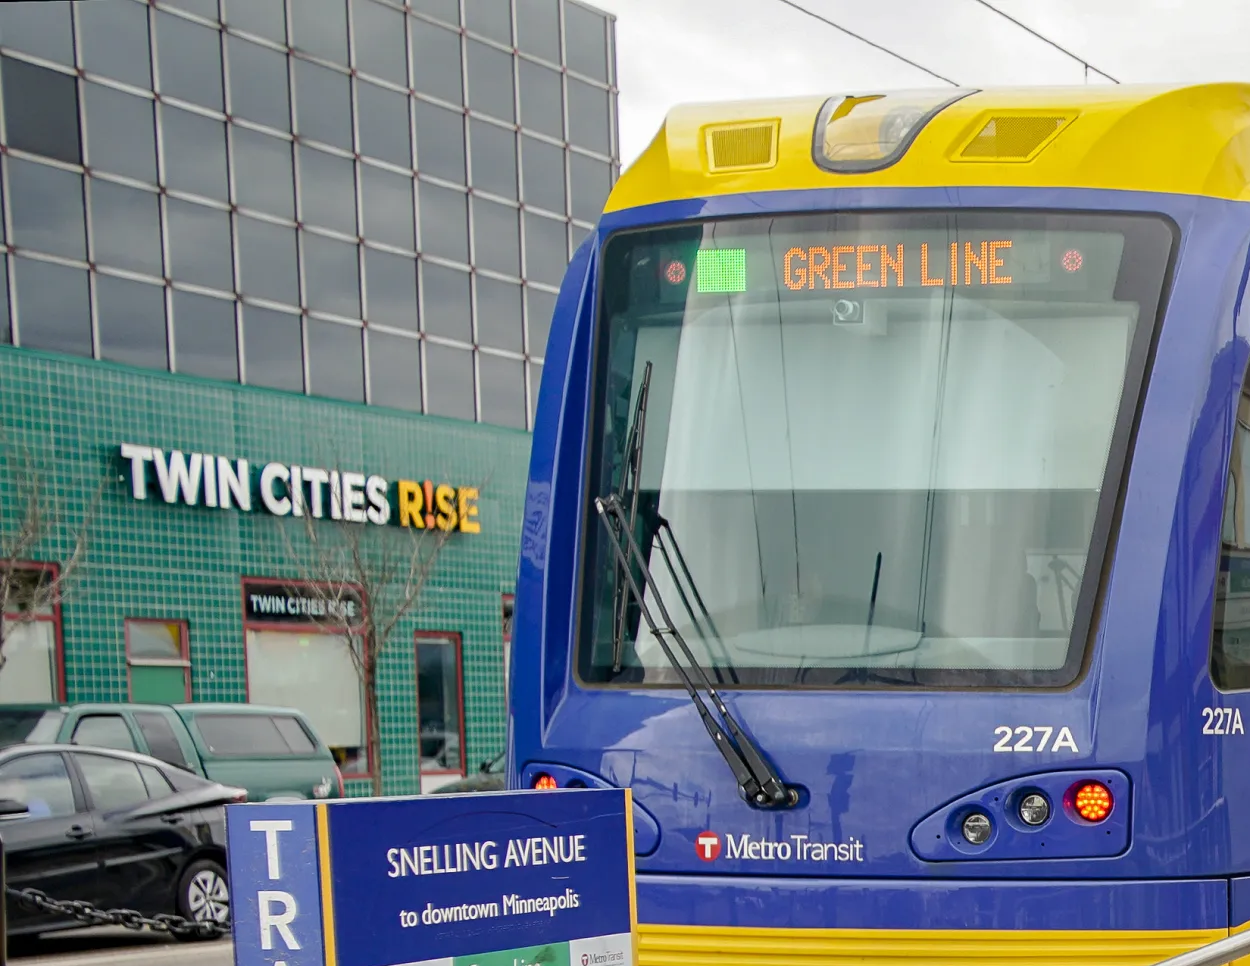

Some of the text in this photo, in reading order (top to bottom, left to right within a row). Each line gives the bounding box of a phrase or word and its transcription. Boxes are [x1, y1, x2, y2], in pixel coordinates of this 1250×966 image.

[784, 240, 1012, 290] GREEN LINE
[120, 443, 251, 511] TWIN
[260, 462, 391, 525] CITIES
[250, 594, 286, 614] TWIN
[993, 726, 1079, 753] 227A
[1202, 707, 1245, 735] 227A
[387, 834, 587, 878] SNELLING AVENUE
[399, 888, 580, 928] to downtown Minneapolis
